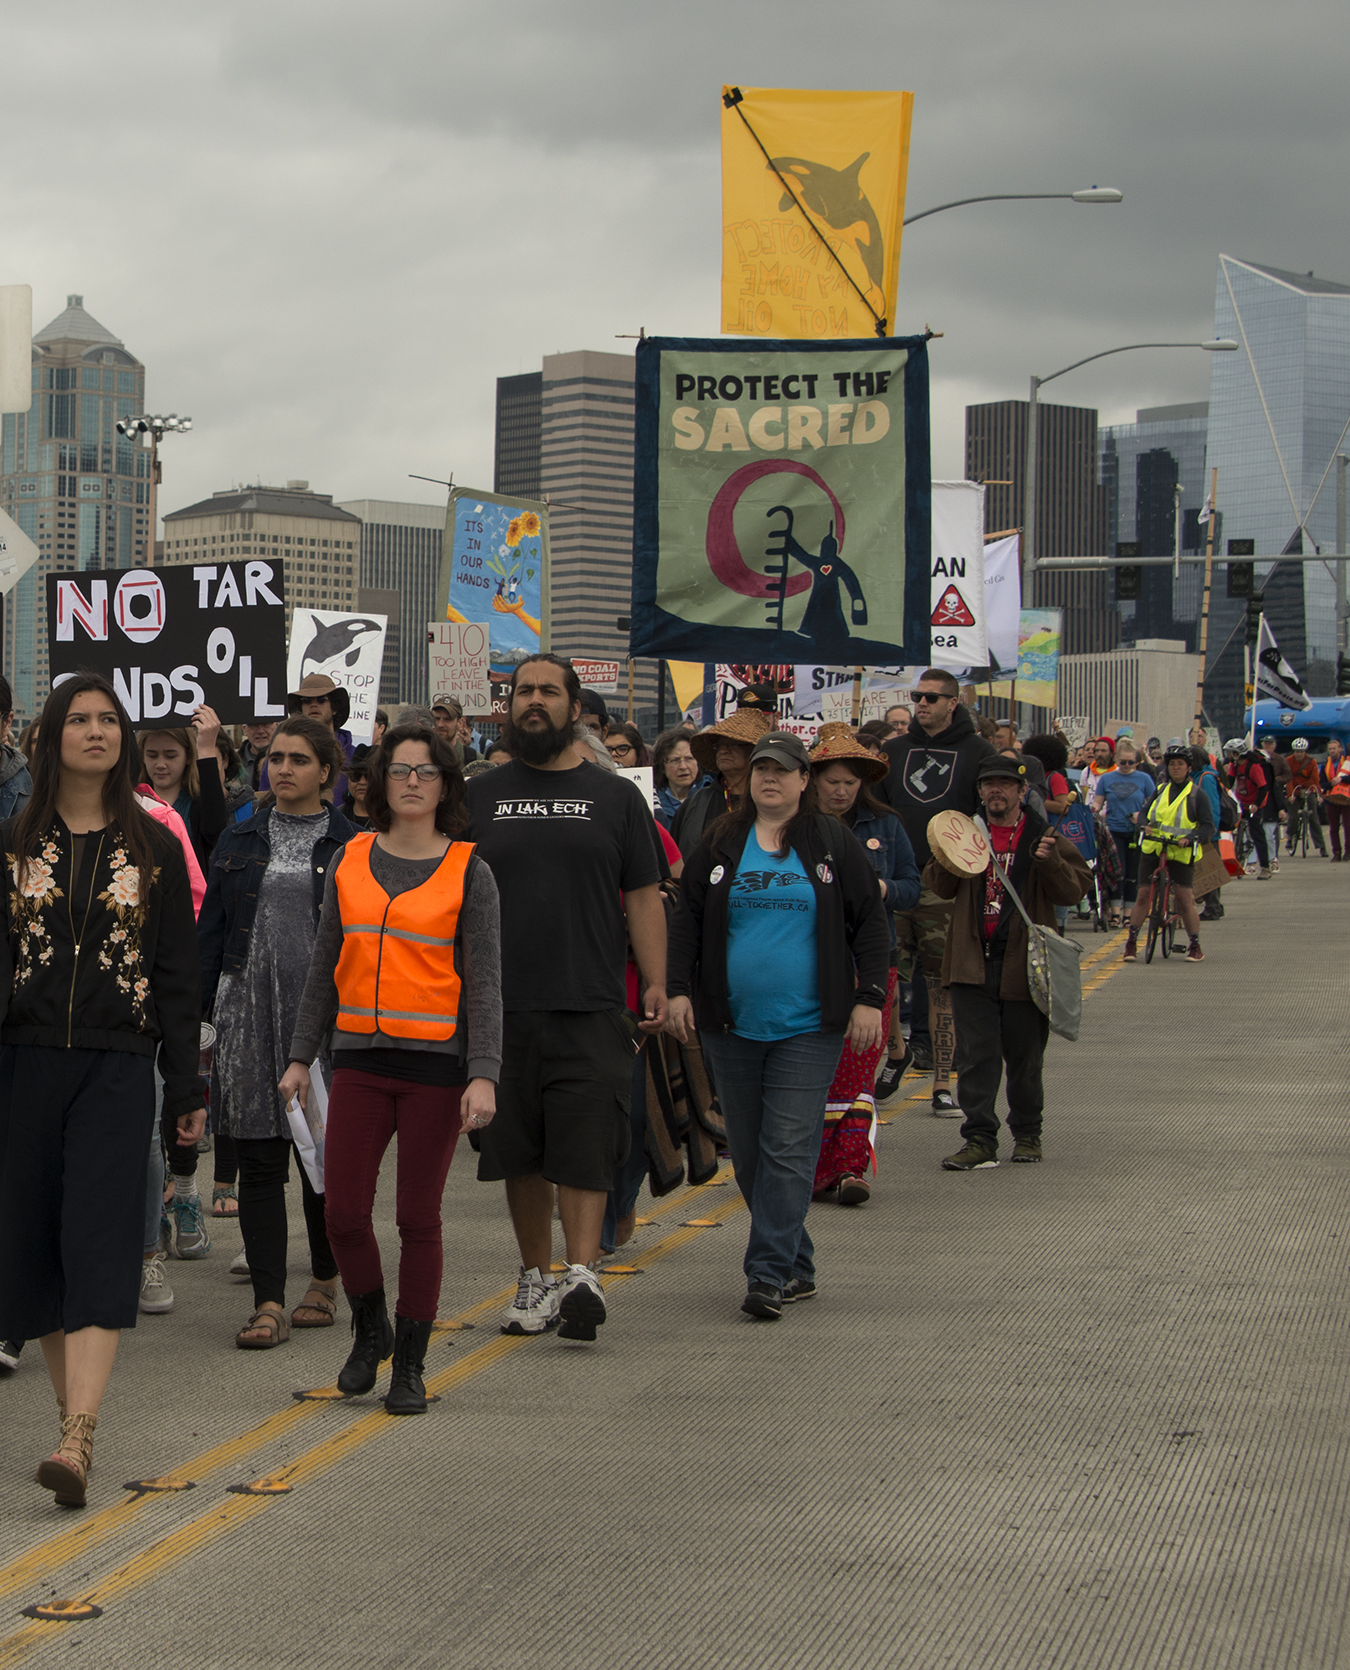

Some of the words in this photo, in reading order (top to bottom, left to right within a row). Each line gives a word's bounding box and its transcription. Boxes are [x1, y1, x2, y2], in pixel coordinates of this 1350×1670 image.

[675, 373, 819, 401] PROTECT
[833, 371, 891, 397] THE
[672, 400, 890, 451] SACRED
[464, 520, 484, 533] ITS
[466, 537, 481, 551] IN
[460, 554, 483, 569] OUR
[456, 572, 491, 589] HANDS
[56, 569, 167, 643] NO
[193, 561, 284, 609] TAR
[440, 624, 485, 656] 410
[931, 635, 958, 648] ea
[432, 656, 455, 667] TOO
[460, 657, 488, 667] HIGH
[52, 665, 206, 722] NDS
[207, 626, 286, 717] OIL
[443, 668, 484, 680] LEAVE
[572, 665, 587, 674] NO
[588, 664, 616, 673] COAL
[330, 670, 375, 687] STOP
[578, 673, 616, 682] XPORTS
[437, 681, 447, 690] IT
[451, 682, 463, 690] IN
[464, 680, 484, 690] THE
[349, 692, 368, 704] HE
[433, 693, 487, 708] GUND
[861, 691, 887, 706] ARE
[893, 690, 913, 703] TH
[349, 710, 370, 720] INE
[494, 804, 513, 815] IN
[552, 803, 589, 815] ECH
[942, 816, 965, 846] NO
[956, 833, 987, 872] LNG
[728, 900, 809, 912] ULL-TOGETHER.CA
